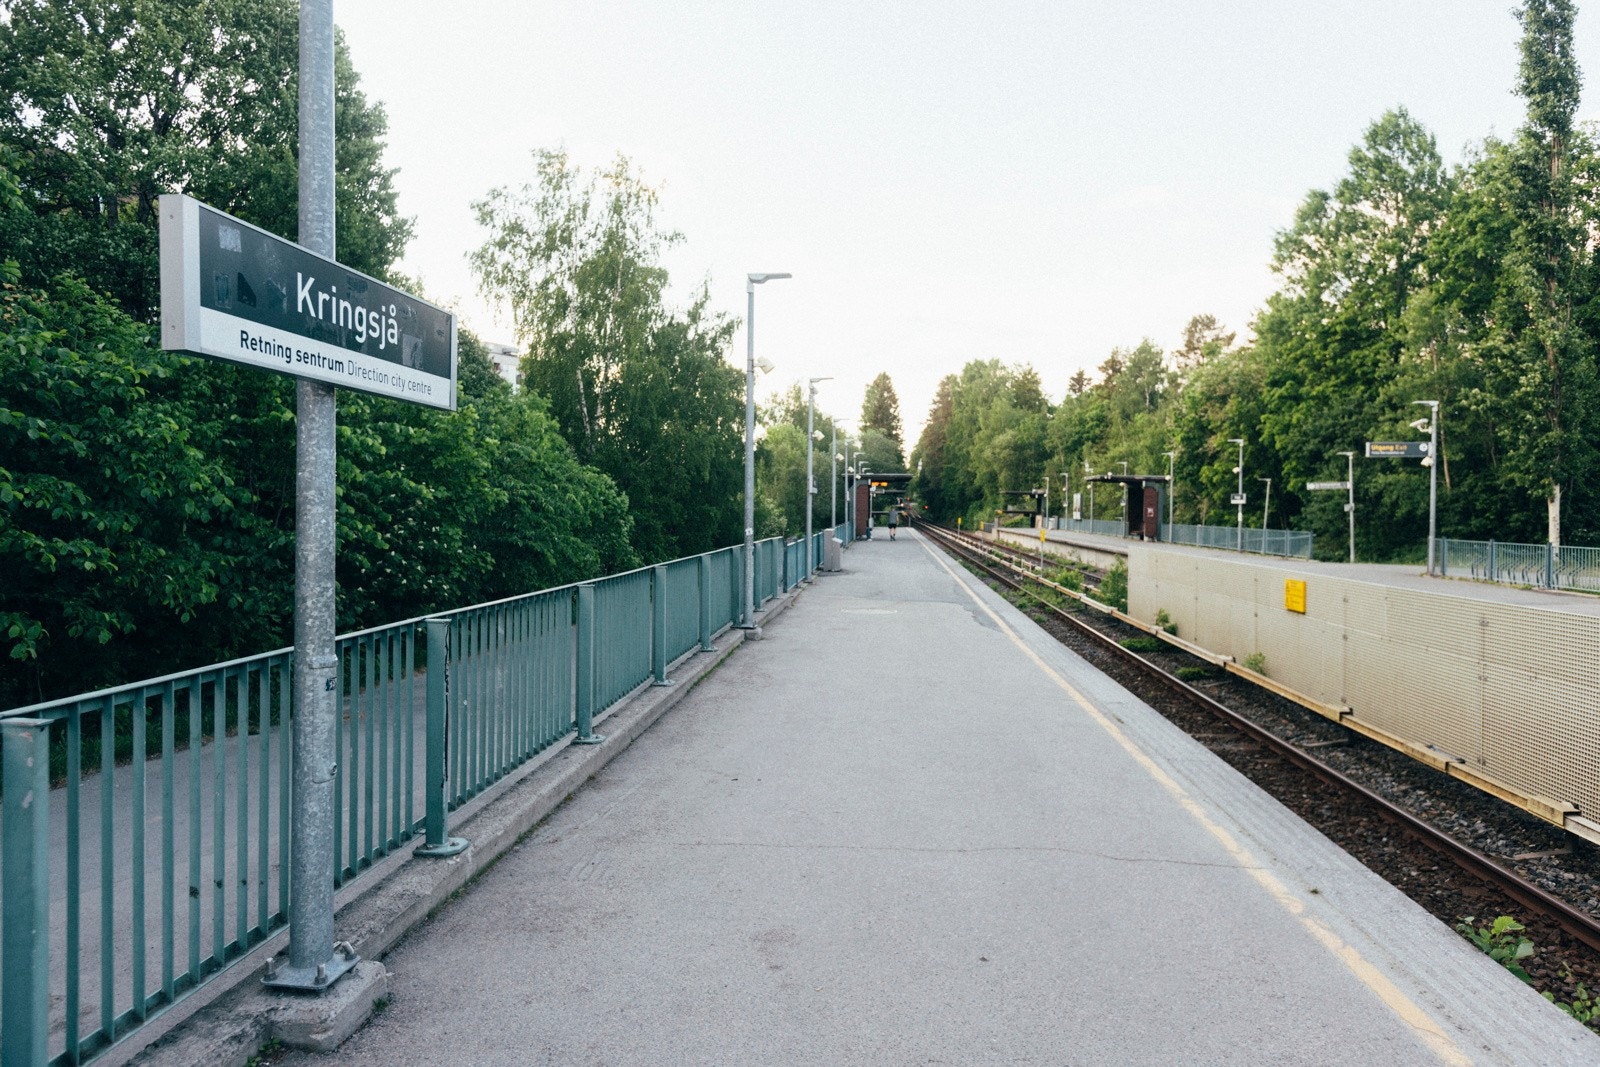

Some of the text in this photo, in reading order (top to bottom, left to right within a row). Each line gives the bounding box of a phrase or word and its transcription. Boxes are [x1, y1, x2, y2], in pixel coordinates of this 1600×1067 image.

[296, 272, 398, 350] Kringsjå
[240, 330, 432, 395] Retning sentrum Direction city centre
